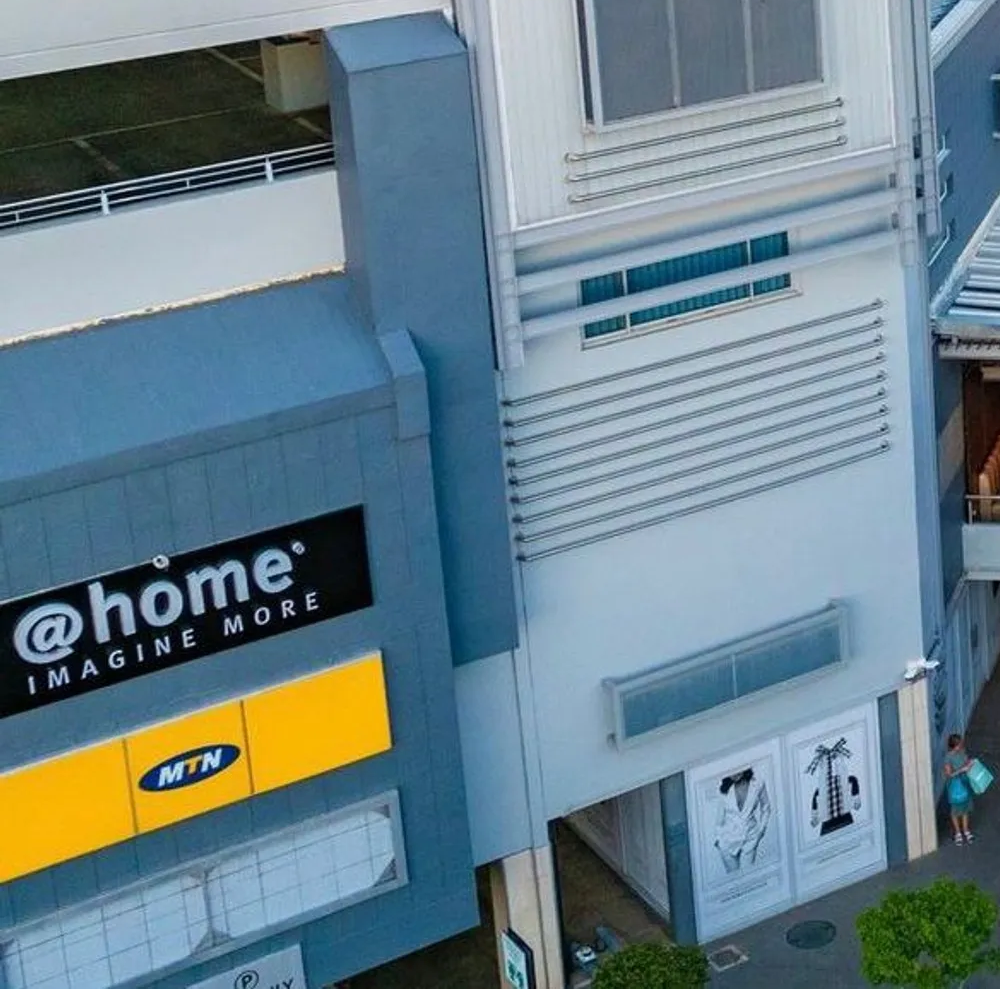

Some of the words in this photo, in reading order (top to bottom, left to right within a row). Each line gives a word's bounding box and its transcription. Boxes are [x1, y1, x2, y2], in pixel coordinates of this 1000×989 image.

[27, 628, 197, 695] IMAGINE
[222, 590, 320, 637] MORE
[156, 748, 223, 788] MTN
